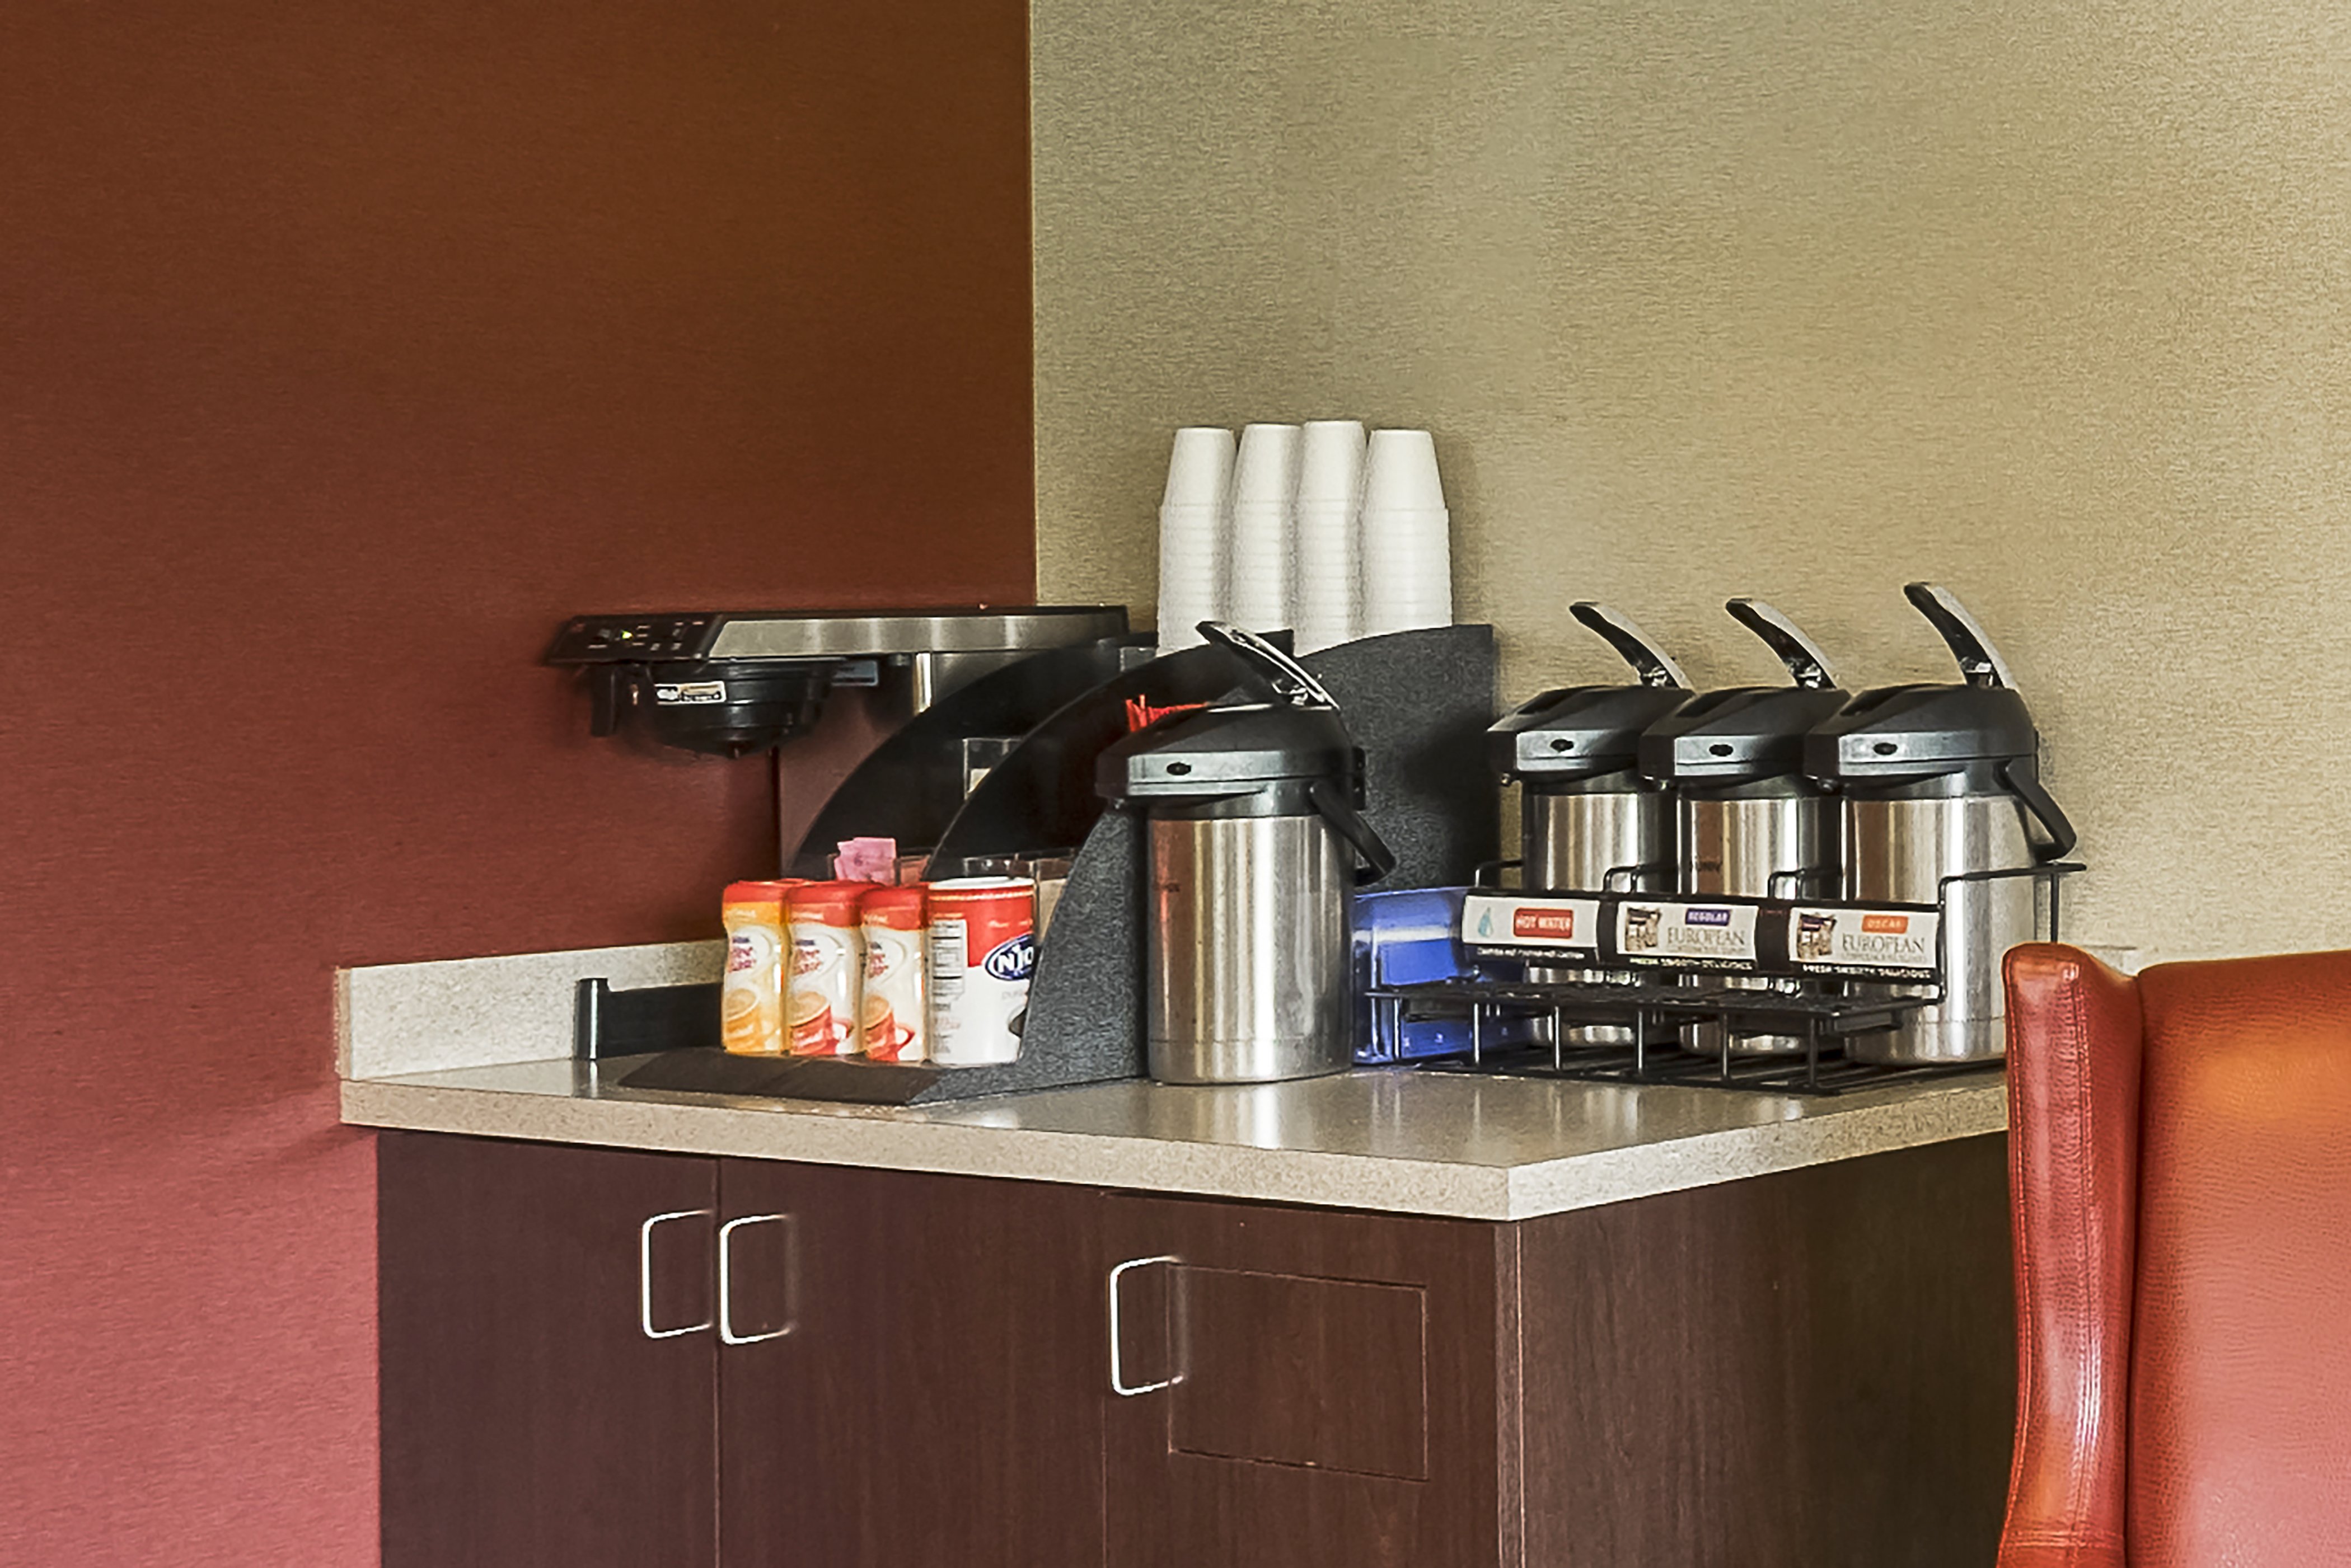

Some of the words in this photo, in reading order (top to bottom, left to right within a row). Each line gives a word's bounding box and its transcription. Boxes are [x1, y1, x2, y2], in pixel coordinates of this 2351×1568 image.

[1515, 915, 1537, 929] HOT
[1538, 916, 1571, 931] WATER
[1687, 911, 1729, 923] REGULAR
[1667, 927, 1745, 946] EUROPEAN
[1842, 932, 1925, 954] EUROPEAN
[997, 944, 1034, 973] NJO
